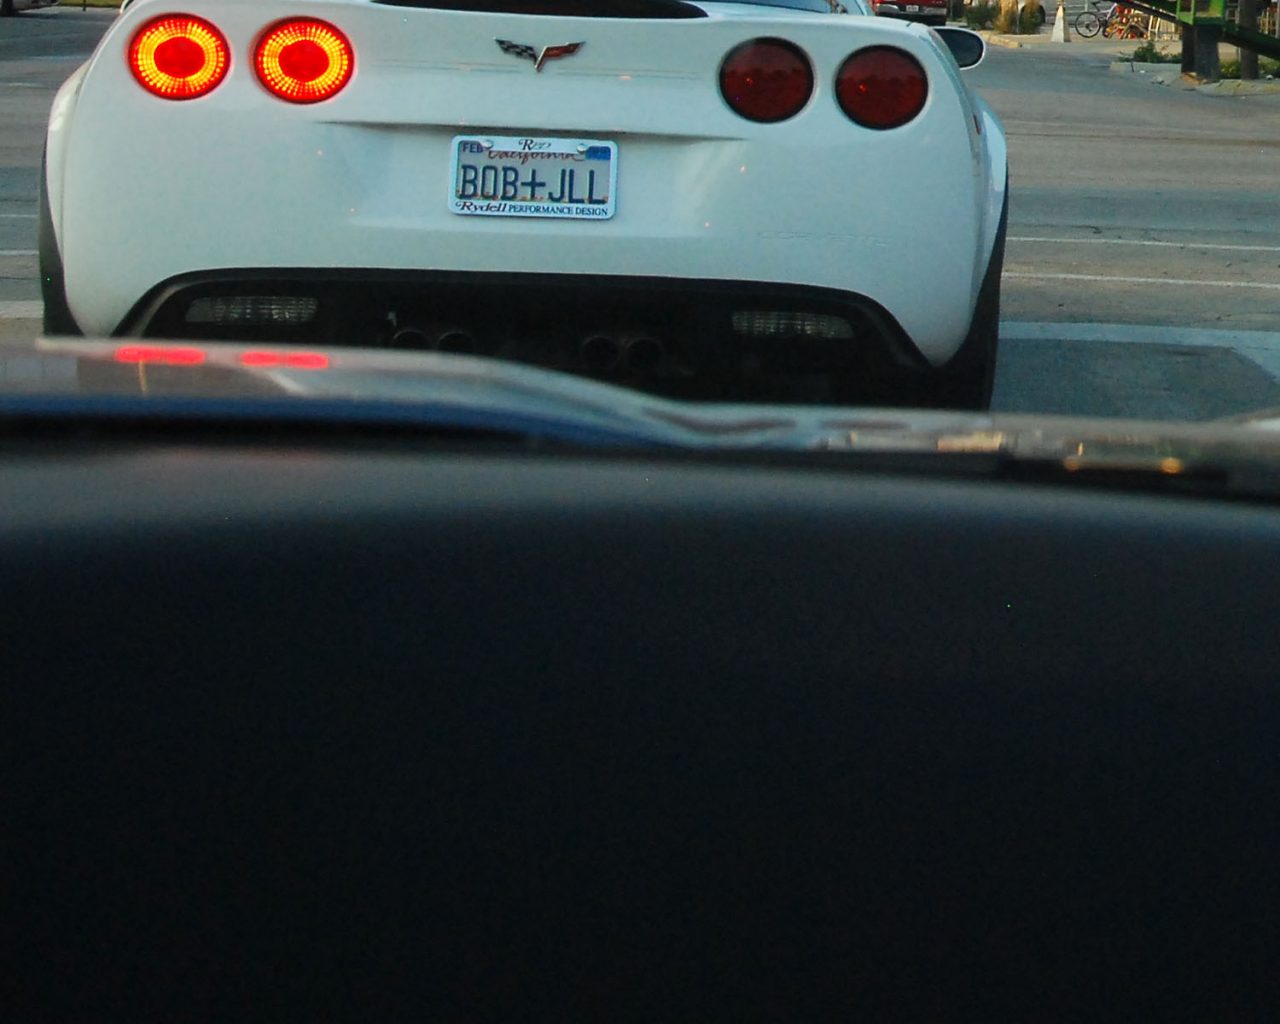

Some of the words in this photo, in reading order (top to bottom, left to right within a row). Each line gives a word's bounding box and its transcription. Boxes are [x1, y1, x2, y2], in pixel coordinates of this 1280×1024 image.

[455, 201, 507, 213] Rydell
[508, 204, 574, 215] PERFORMANCE
[575, 207, 608, 216] DESIGN
